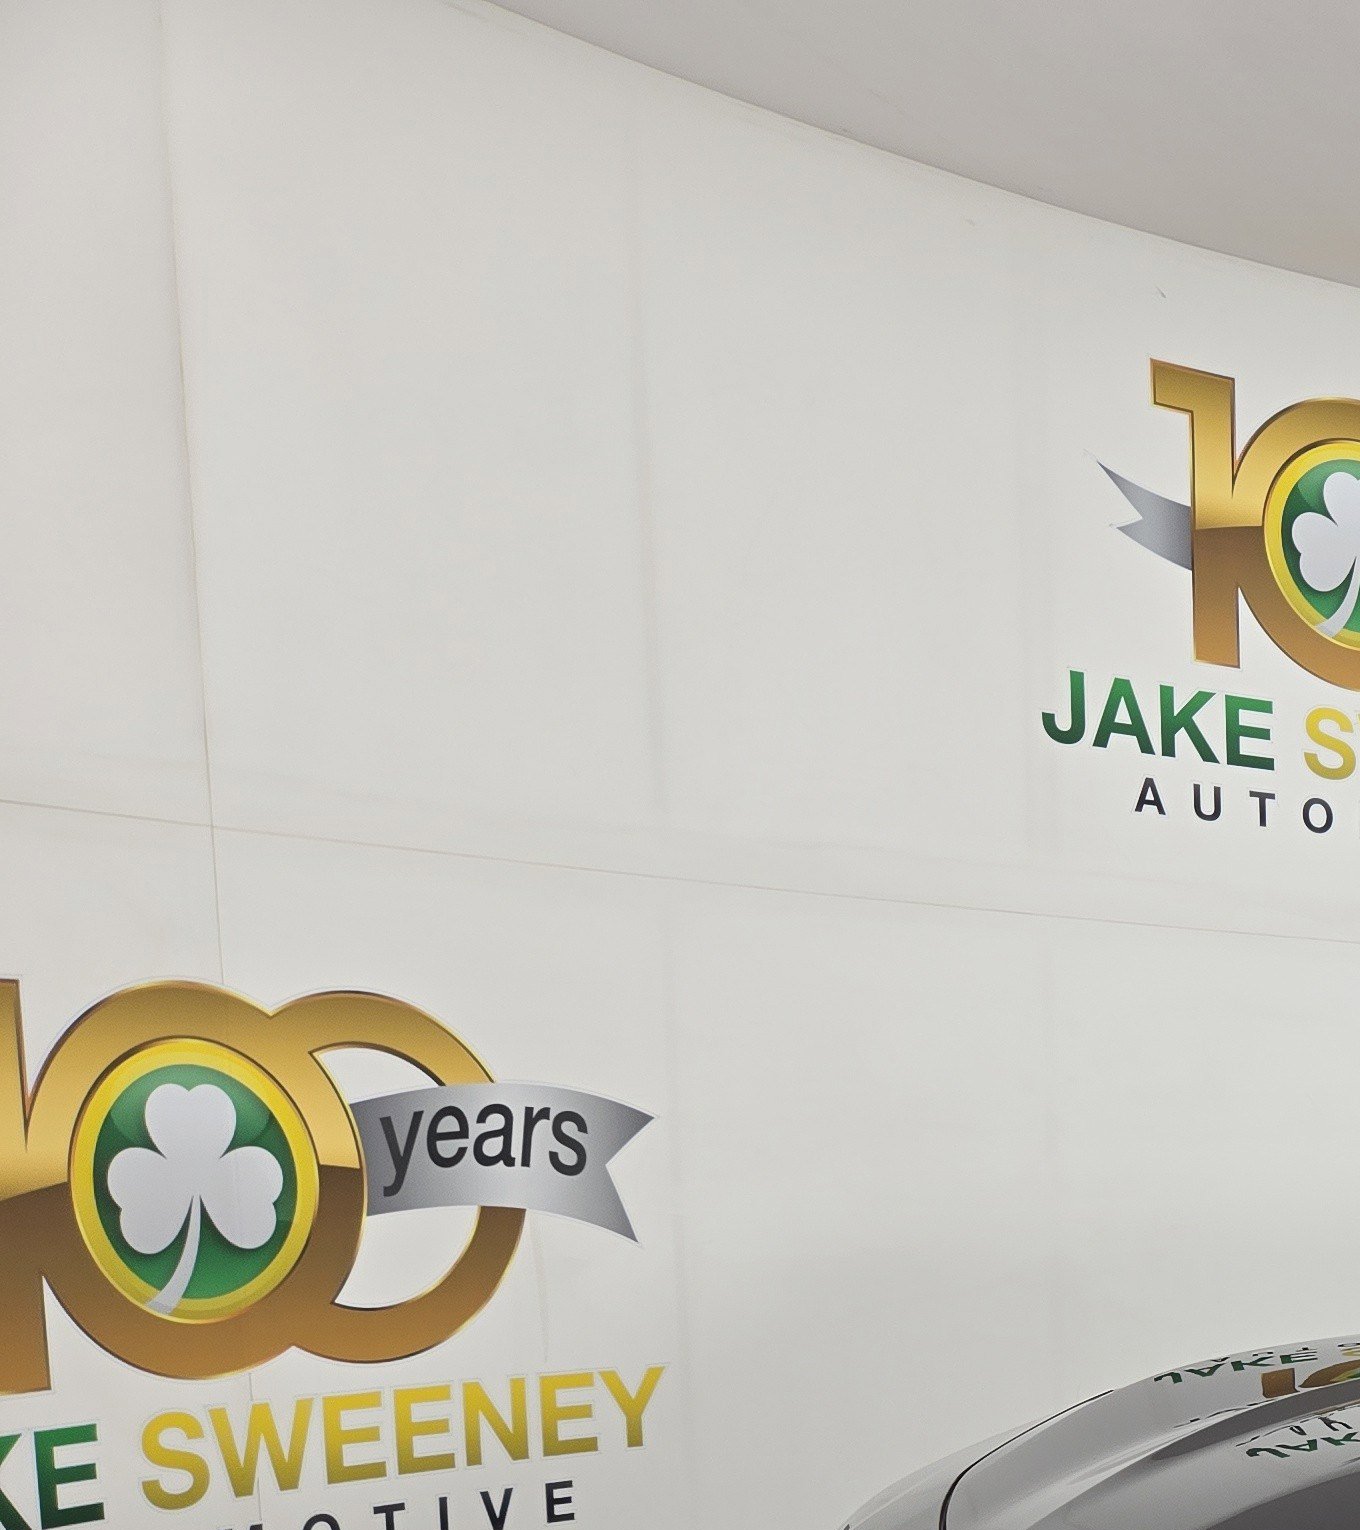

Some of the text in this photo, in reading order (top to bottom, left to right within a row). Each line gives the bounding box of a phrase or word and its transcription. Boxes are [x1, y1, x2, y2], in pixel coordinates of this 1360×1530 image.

[1041, 669, 1276, 772] JAKE
[379, 1102, 589, 1197] years
[140, 1366, 666, 1511] SWEENEY
